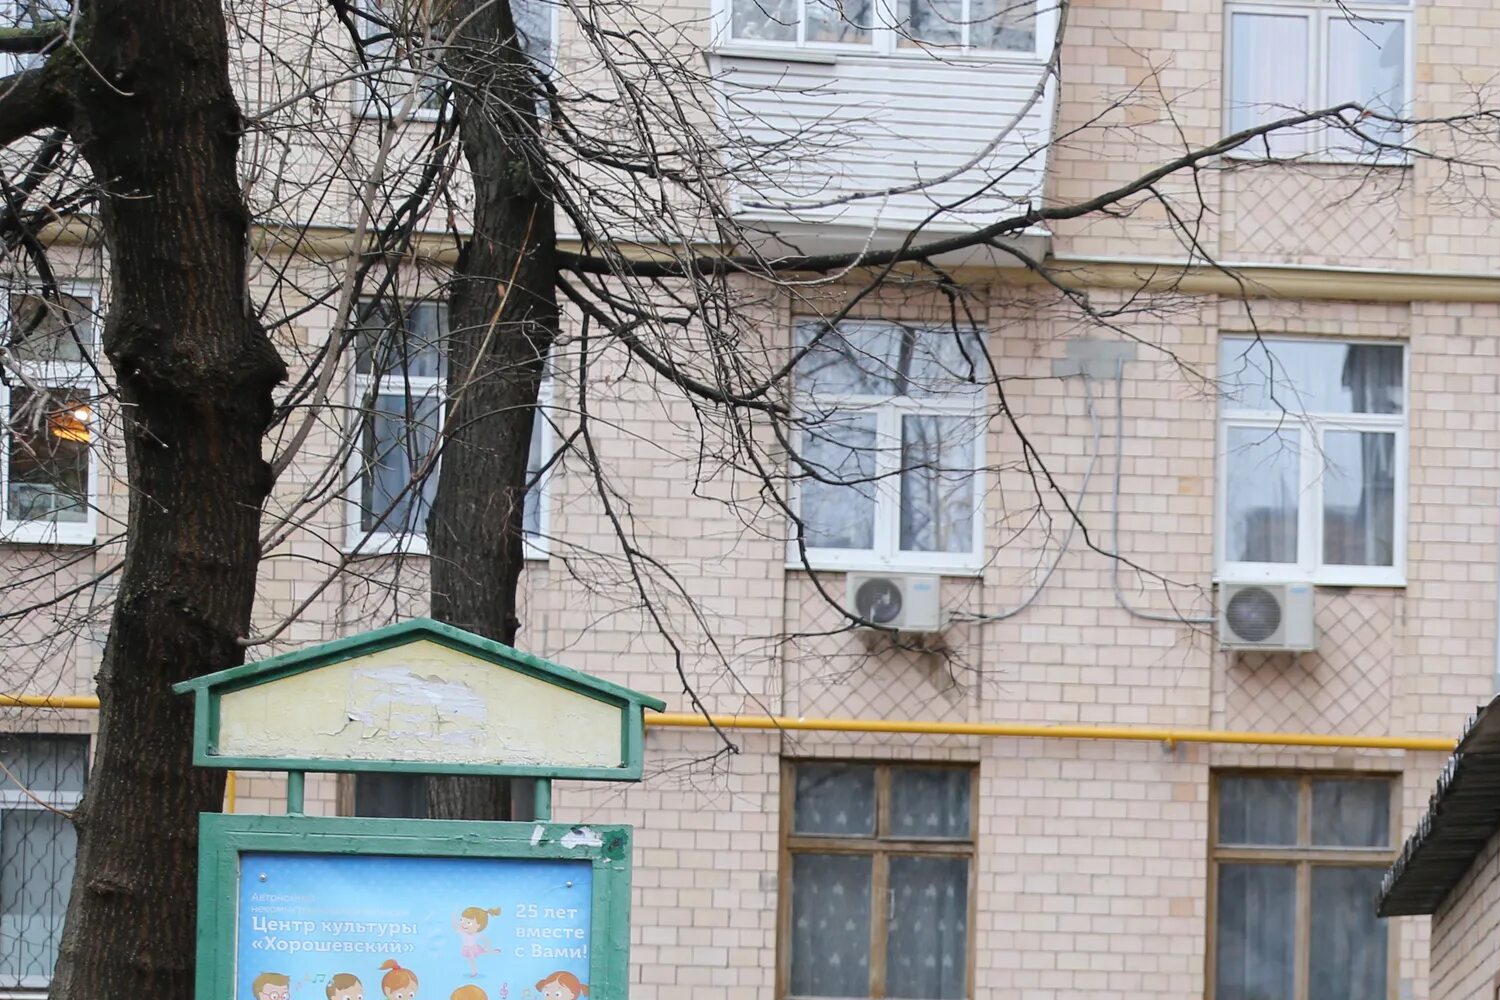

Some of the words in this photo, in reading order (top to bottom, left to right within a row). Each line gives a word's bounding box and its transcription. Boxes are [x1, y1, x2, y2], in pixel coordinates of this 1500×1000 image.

[515, 903, 538, 919] 25
[543, 907, 578, 919] лет
[252, 916, 316, 934] Центр
[321, 920, 418, 937] культуры
[515, 927, 585, 939] вместе
[251, 936, 415, 954] «Хорошевский»
[514, 946, 525, 958] с
[530, 943, 588, 959] Вами!
